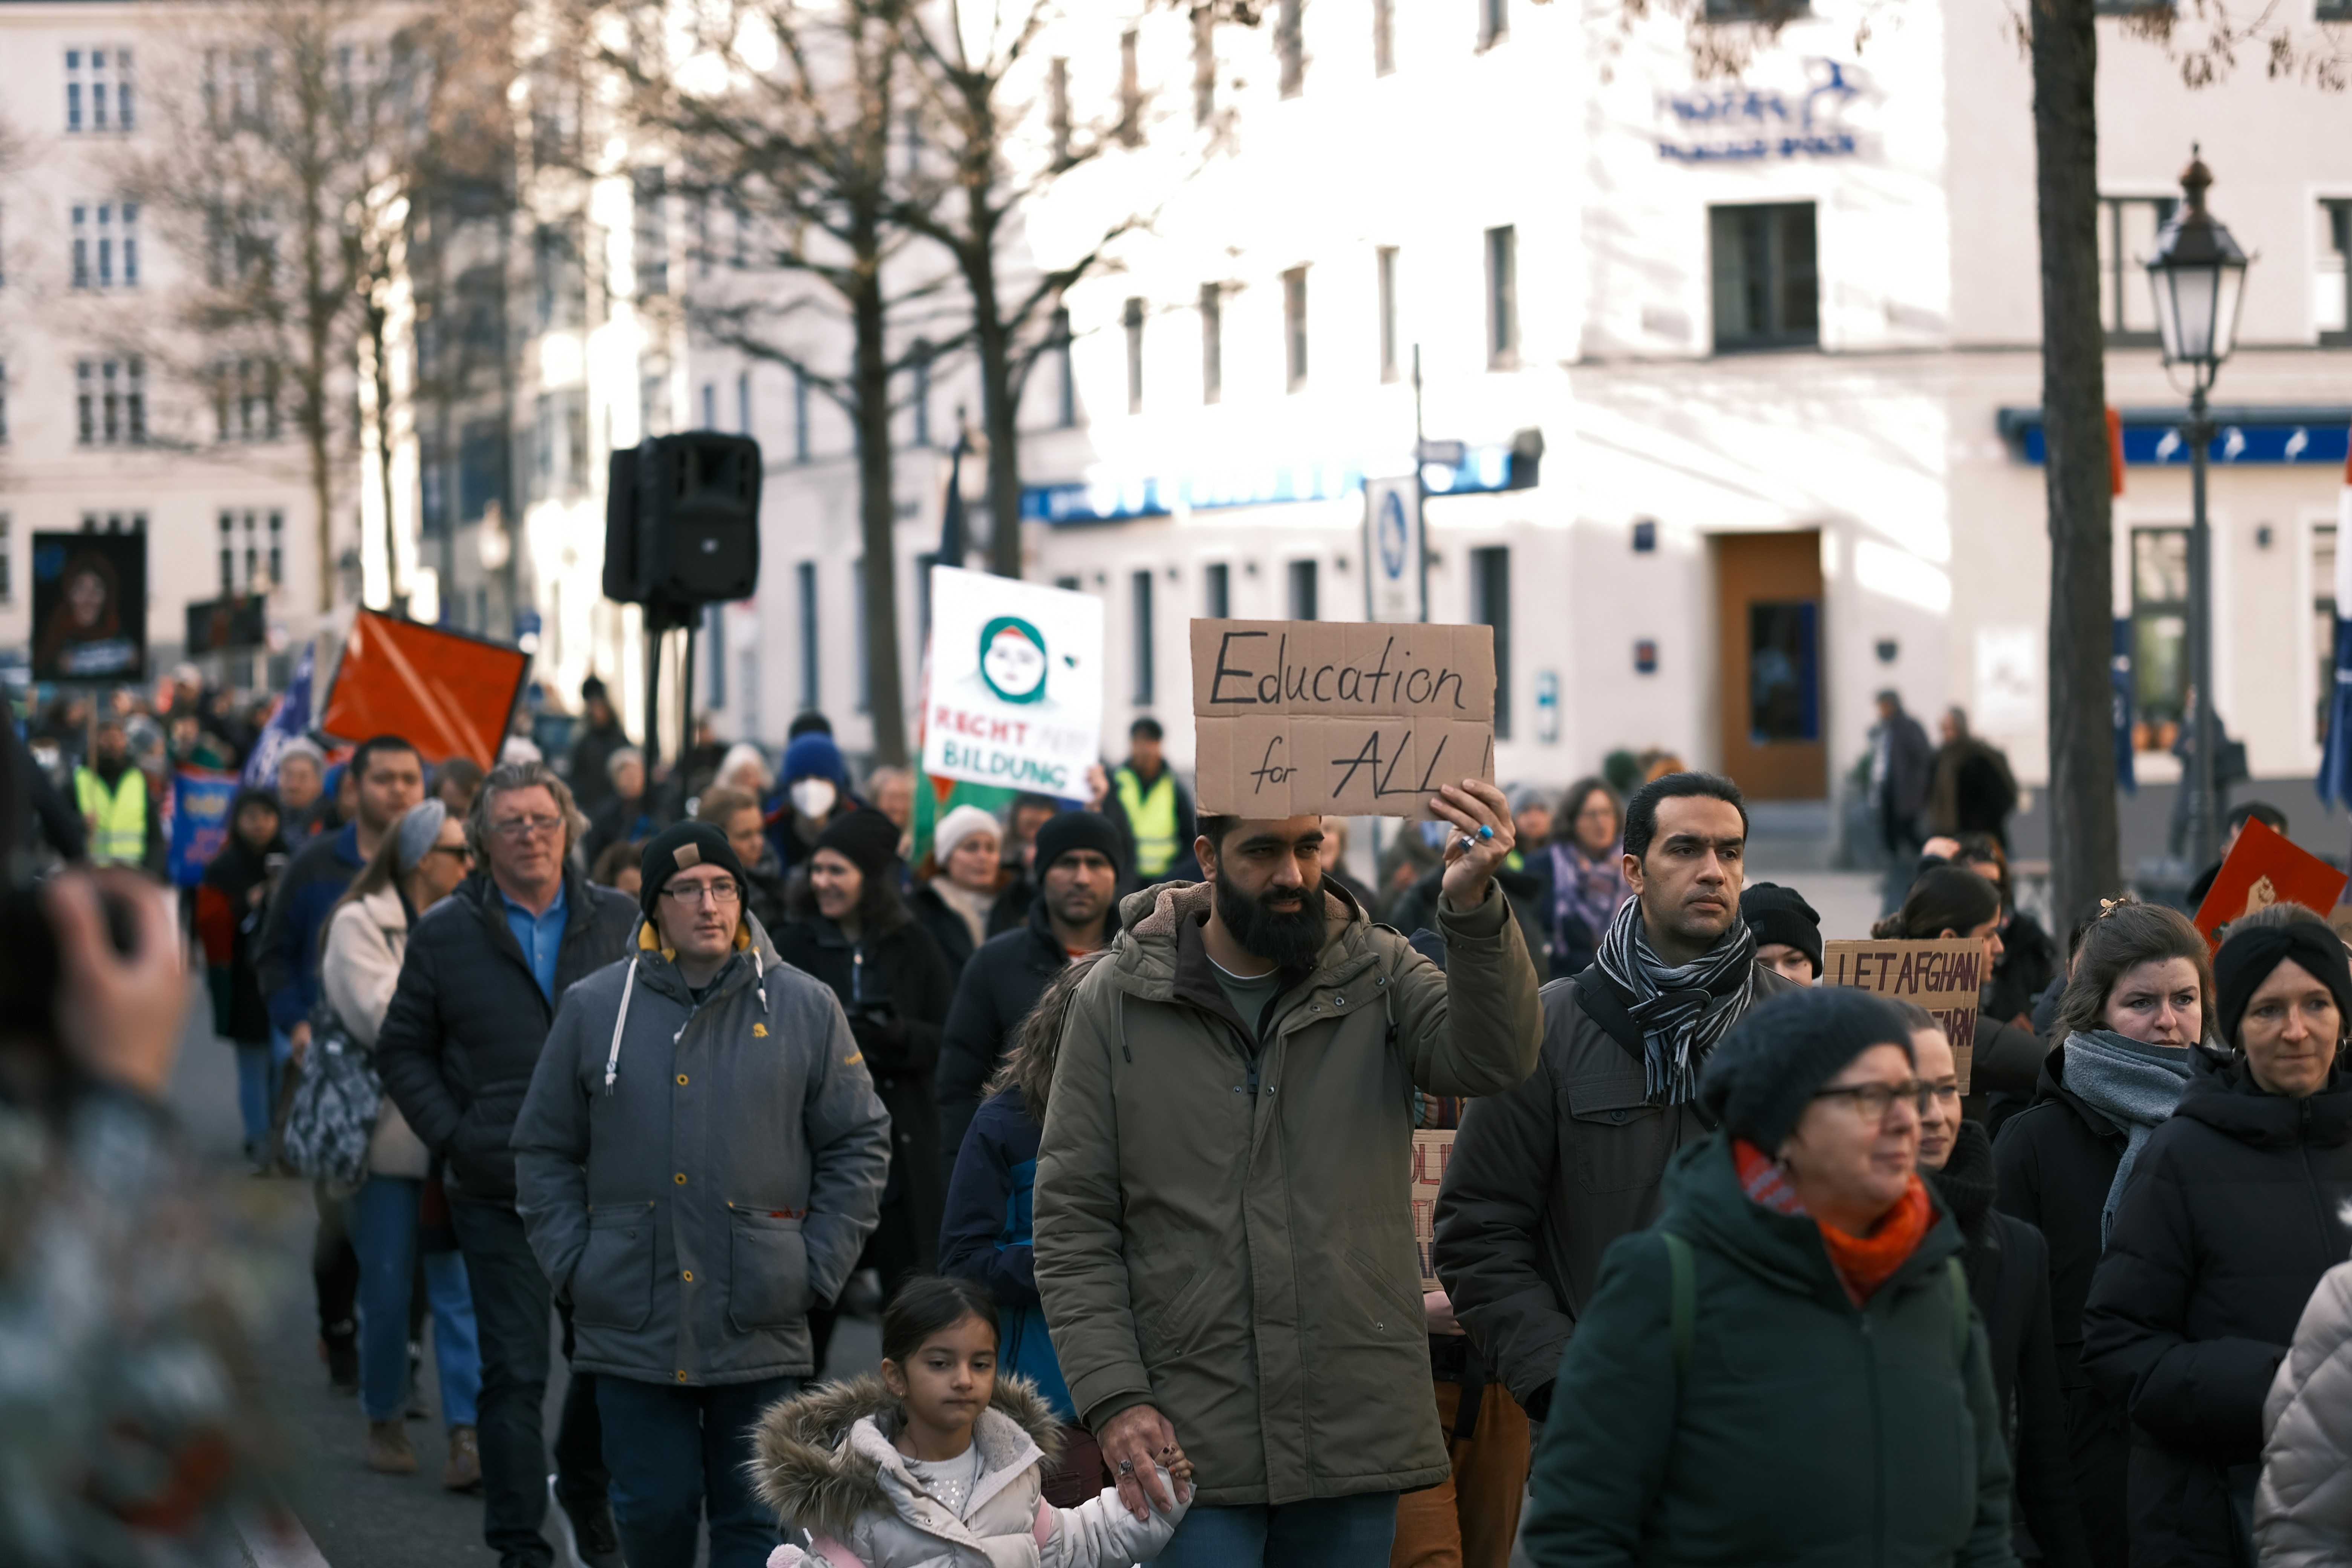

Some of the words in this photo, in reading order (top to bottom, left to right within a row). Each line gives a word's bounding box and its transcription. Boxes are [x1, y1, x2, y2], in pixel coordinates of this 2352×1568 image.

[1210, 631, 1466, 709] Education
[934, 704, 1030, 745] RECHT
[942, 738, 1068, 790] BILDUNG
[1251, 735, 1297, 795] for
[1838, 953, 1897, 991] LET
[1894, 951, 1980, 994] AFGHAN
